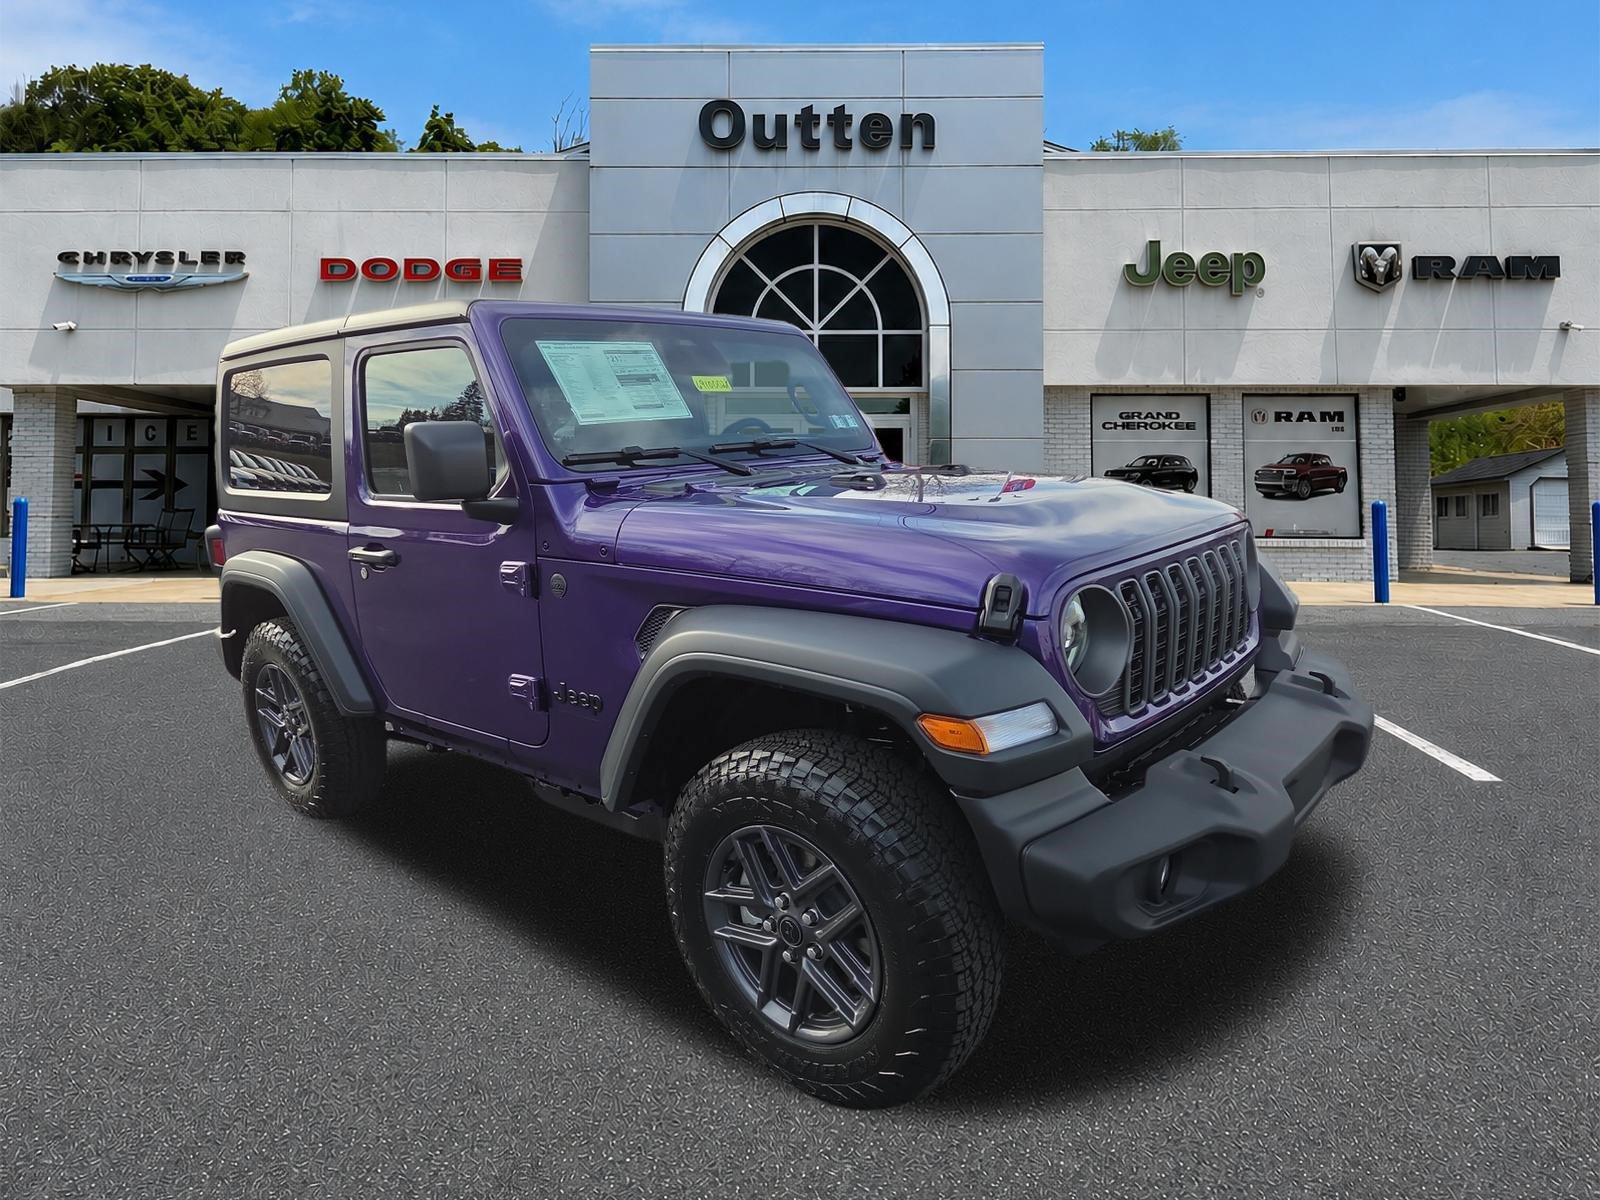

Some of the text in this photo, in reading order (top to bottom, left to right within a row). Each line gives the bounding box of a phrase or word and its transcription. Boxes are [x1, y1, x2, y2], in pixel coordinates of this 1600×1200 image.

[698, 99, 936, 150] Outten
[56, 250, 247, 266] CHRYSLER
[320, 257, 523, 282] DODGE
[1123, 240, 1266, 297] Jeep
[1411, 255, 1561, 280] RAM
[1101, 421, 1197, 431] CHEROKEE
[1118, 411, 1181, 421] GRAND
[1273, 411, 1345, 423] RAM
[553, 682, 604, 716] Jeep
